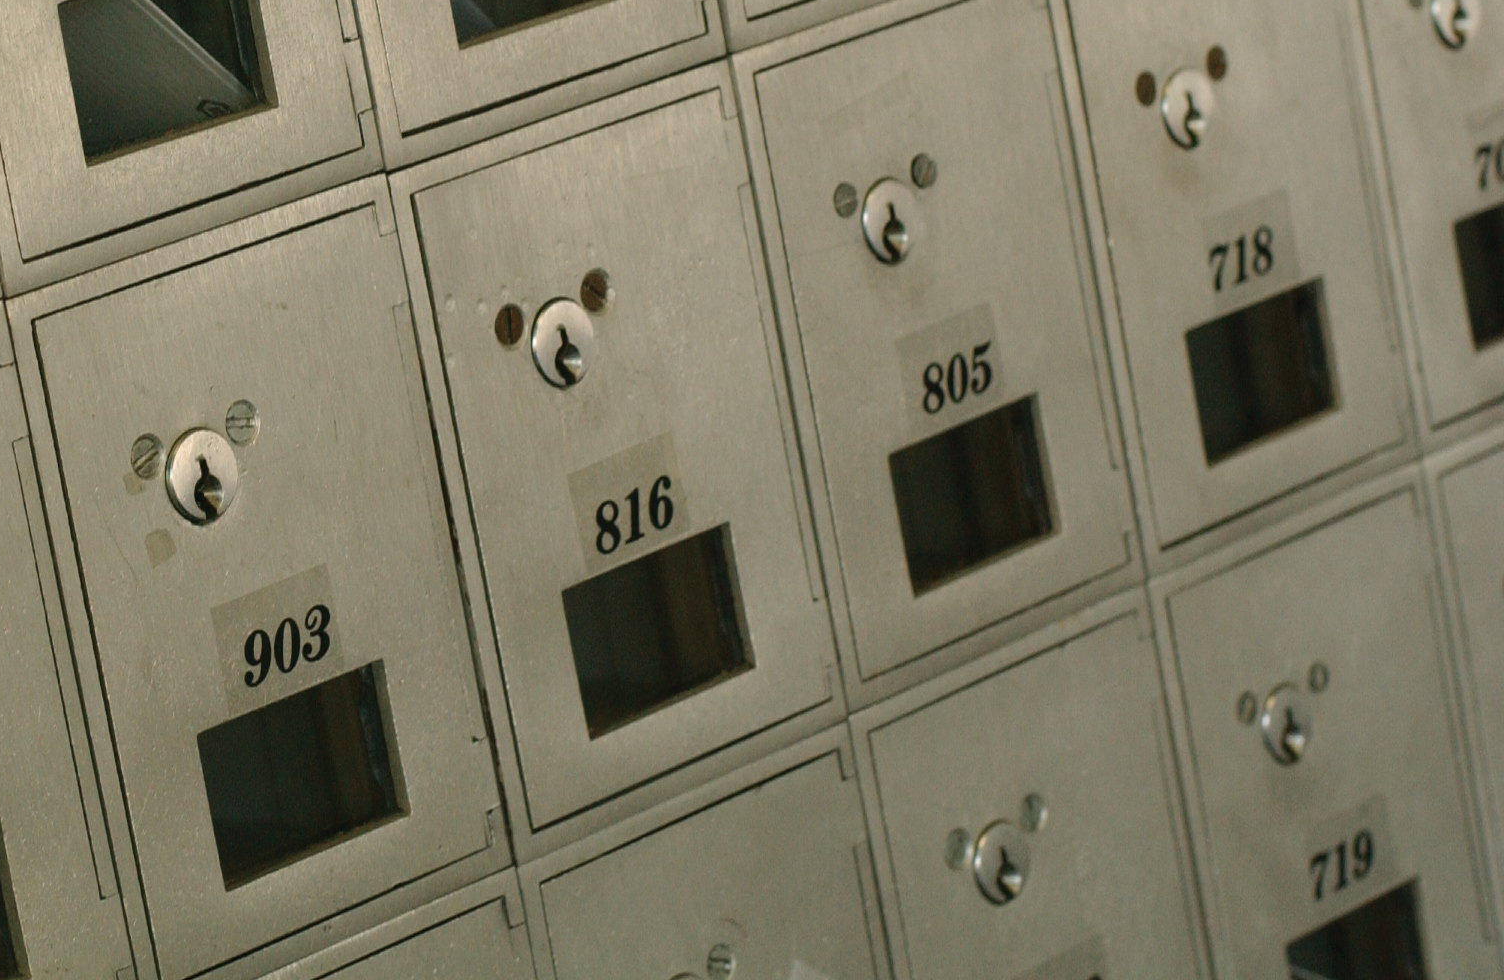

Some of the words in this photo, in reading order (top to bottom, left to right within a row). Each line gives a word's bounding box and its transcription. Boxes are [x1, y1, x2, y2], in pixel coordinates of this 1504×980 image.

[1210, 228, 1273, 291] 718
[923, 342, 993, 415] 805
[596, 476, 675, 555] 816
[244, 605, 332, 688] 903
[1309, 829, 1374, 901] 719
